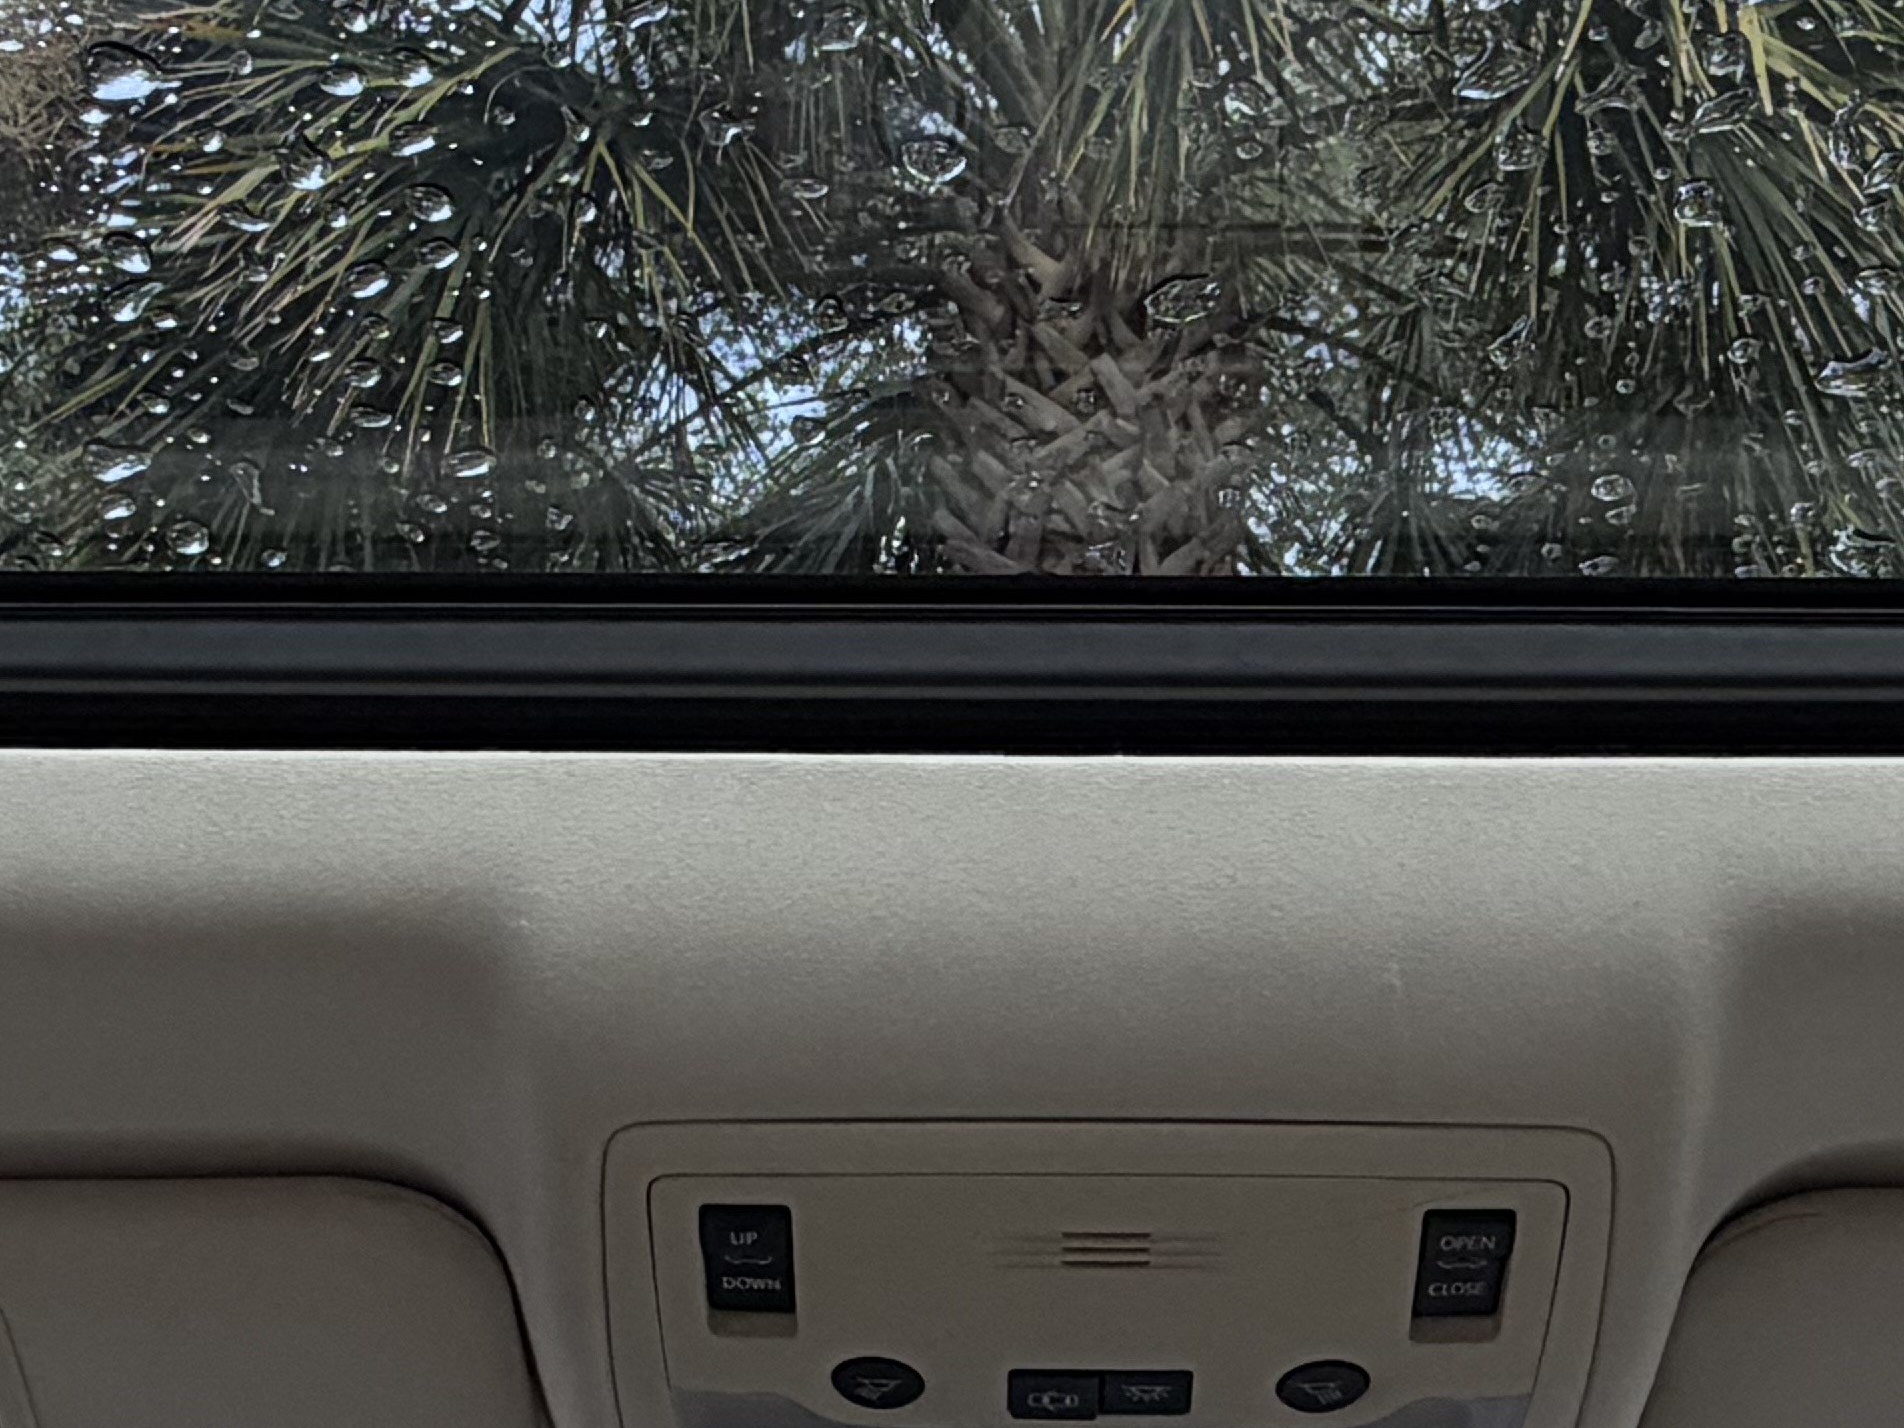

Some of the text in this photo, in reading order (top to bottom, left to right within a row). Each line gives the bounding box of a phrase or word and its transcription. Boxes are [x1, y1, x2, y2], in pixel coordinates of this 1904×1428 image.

[729, 1231, 758, 1246] UP
[1439, 1234, 1496, 1251] OPEN
[721, 1275, 782, 1291] DOWN
[1427, 1281, 1487, 1297] CLOSE
